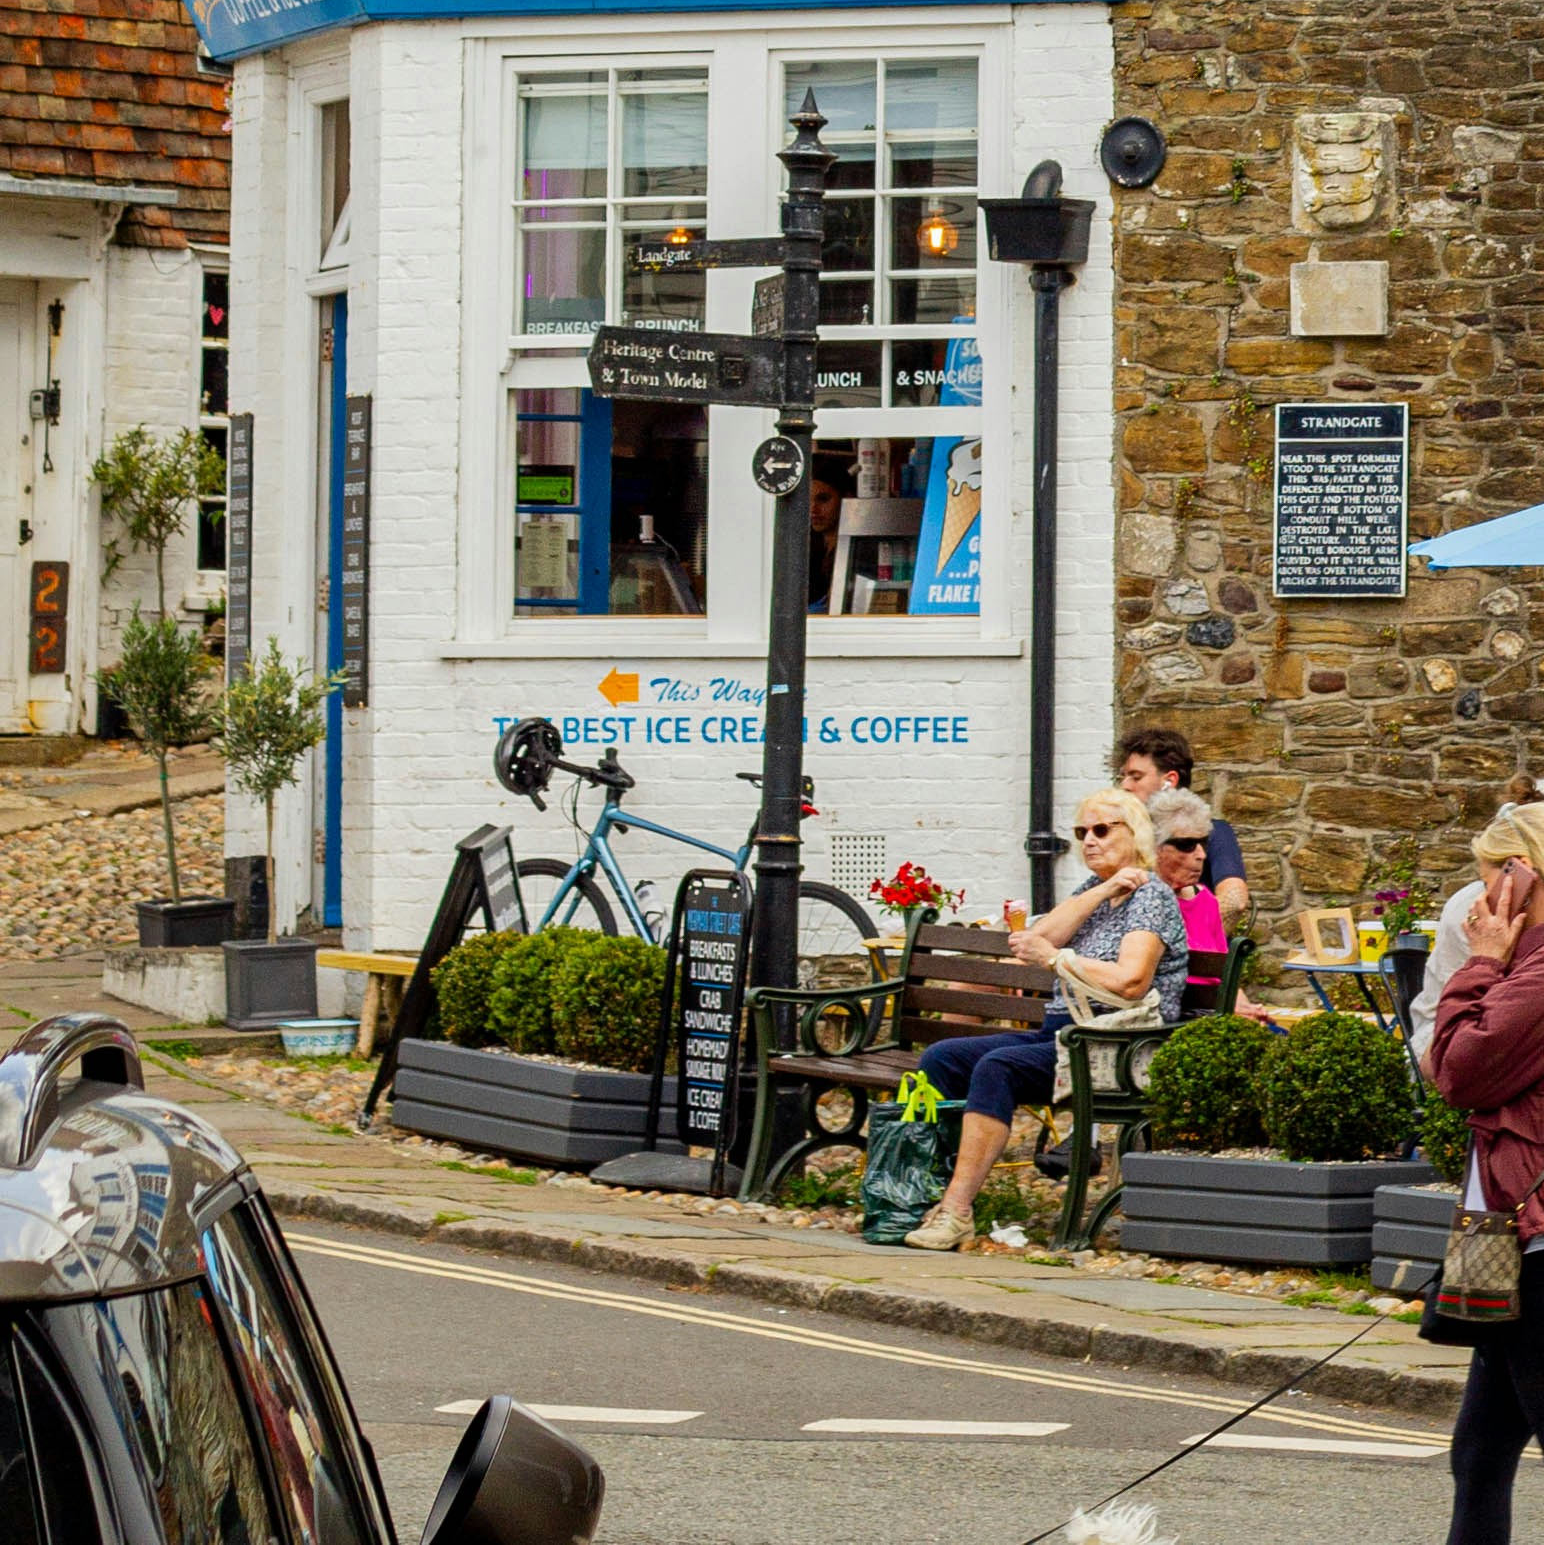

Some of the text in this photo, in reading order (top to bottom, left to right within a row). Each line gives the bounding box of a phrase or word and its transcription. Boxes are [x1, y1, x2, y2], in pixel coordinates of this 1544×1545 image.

[638, 246, 692, 267] Landgate
[603, 339, 716, 364] Heritage Centre
[602, 367, 708, 390] & Town Model
[814, 371, 862, 388] UNCH
[896, 370, 910, 386] &
[1300, 416, 1383, 428] STRANDGATE
[1280, 455, 1401, 463] NEAR THIS SPOT FORMERLY
[1283, 465, 1314, 473] STOOD
[1319, 465, 1336, 473] THE
[1288, 475, 1394, 483] THIS WAS PART OF THE
[1282, 485, 1323, 493] DEFENCES
[1326, 485, 1365, 493] ERECTED
[1366, 485, 1376, 493] IN
[1279, 495, 1403, 504] THIS GATE AND THE POSTERN
[1281, 505, 1398, 514] GATE AT THE BOTTOM OF
[1290, 516, 1389, 524] CONDUIT HILL WERE
[1280, 526, 1397, 534] DESTROYED IN THE LATE
[1349, 535, 1367, 544] THE
[1370, 535, 1399, 544] STONE
[1280, 546, 1398, 554] WITH THE BOROUGH ARMS
[1278, 556, 1401, 565] CARVED ON IT IN THE WALL
[1278, 566, 1402, 575] ABOVE WAS OVER THE CENTRE
[1280, 577, 1304, 585] ARCH
[1306, 577, 1318, 585] OF
[1321, 577, 1337, 585] THE
[927, 584, 971, 603] FLAKE
[650, 677, 767, 708] This Way
[563, 716, 637, 744] BEST
[646, 716, 692, 744] ICE
[701, 716, 808, 744] CRE
[819, 716, 842, 744] &
[850, 716, 969, 744] COFFEE
[689, 939, 736, 961] BREAKFASTS
[697, 962, 734, 983] LUNCHES
[699, 990, 722, 1009] CRAB
[684, 1010, 733, 1032] SANDWICHE
[686, 1038, 730, 1059] HOMEMAD
[687, 1088, 700, 1107] ICE
[696, 1111, 721, 1131] COFFE
